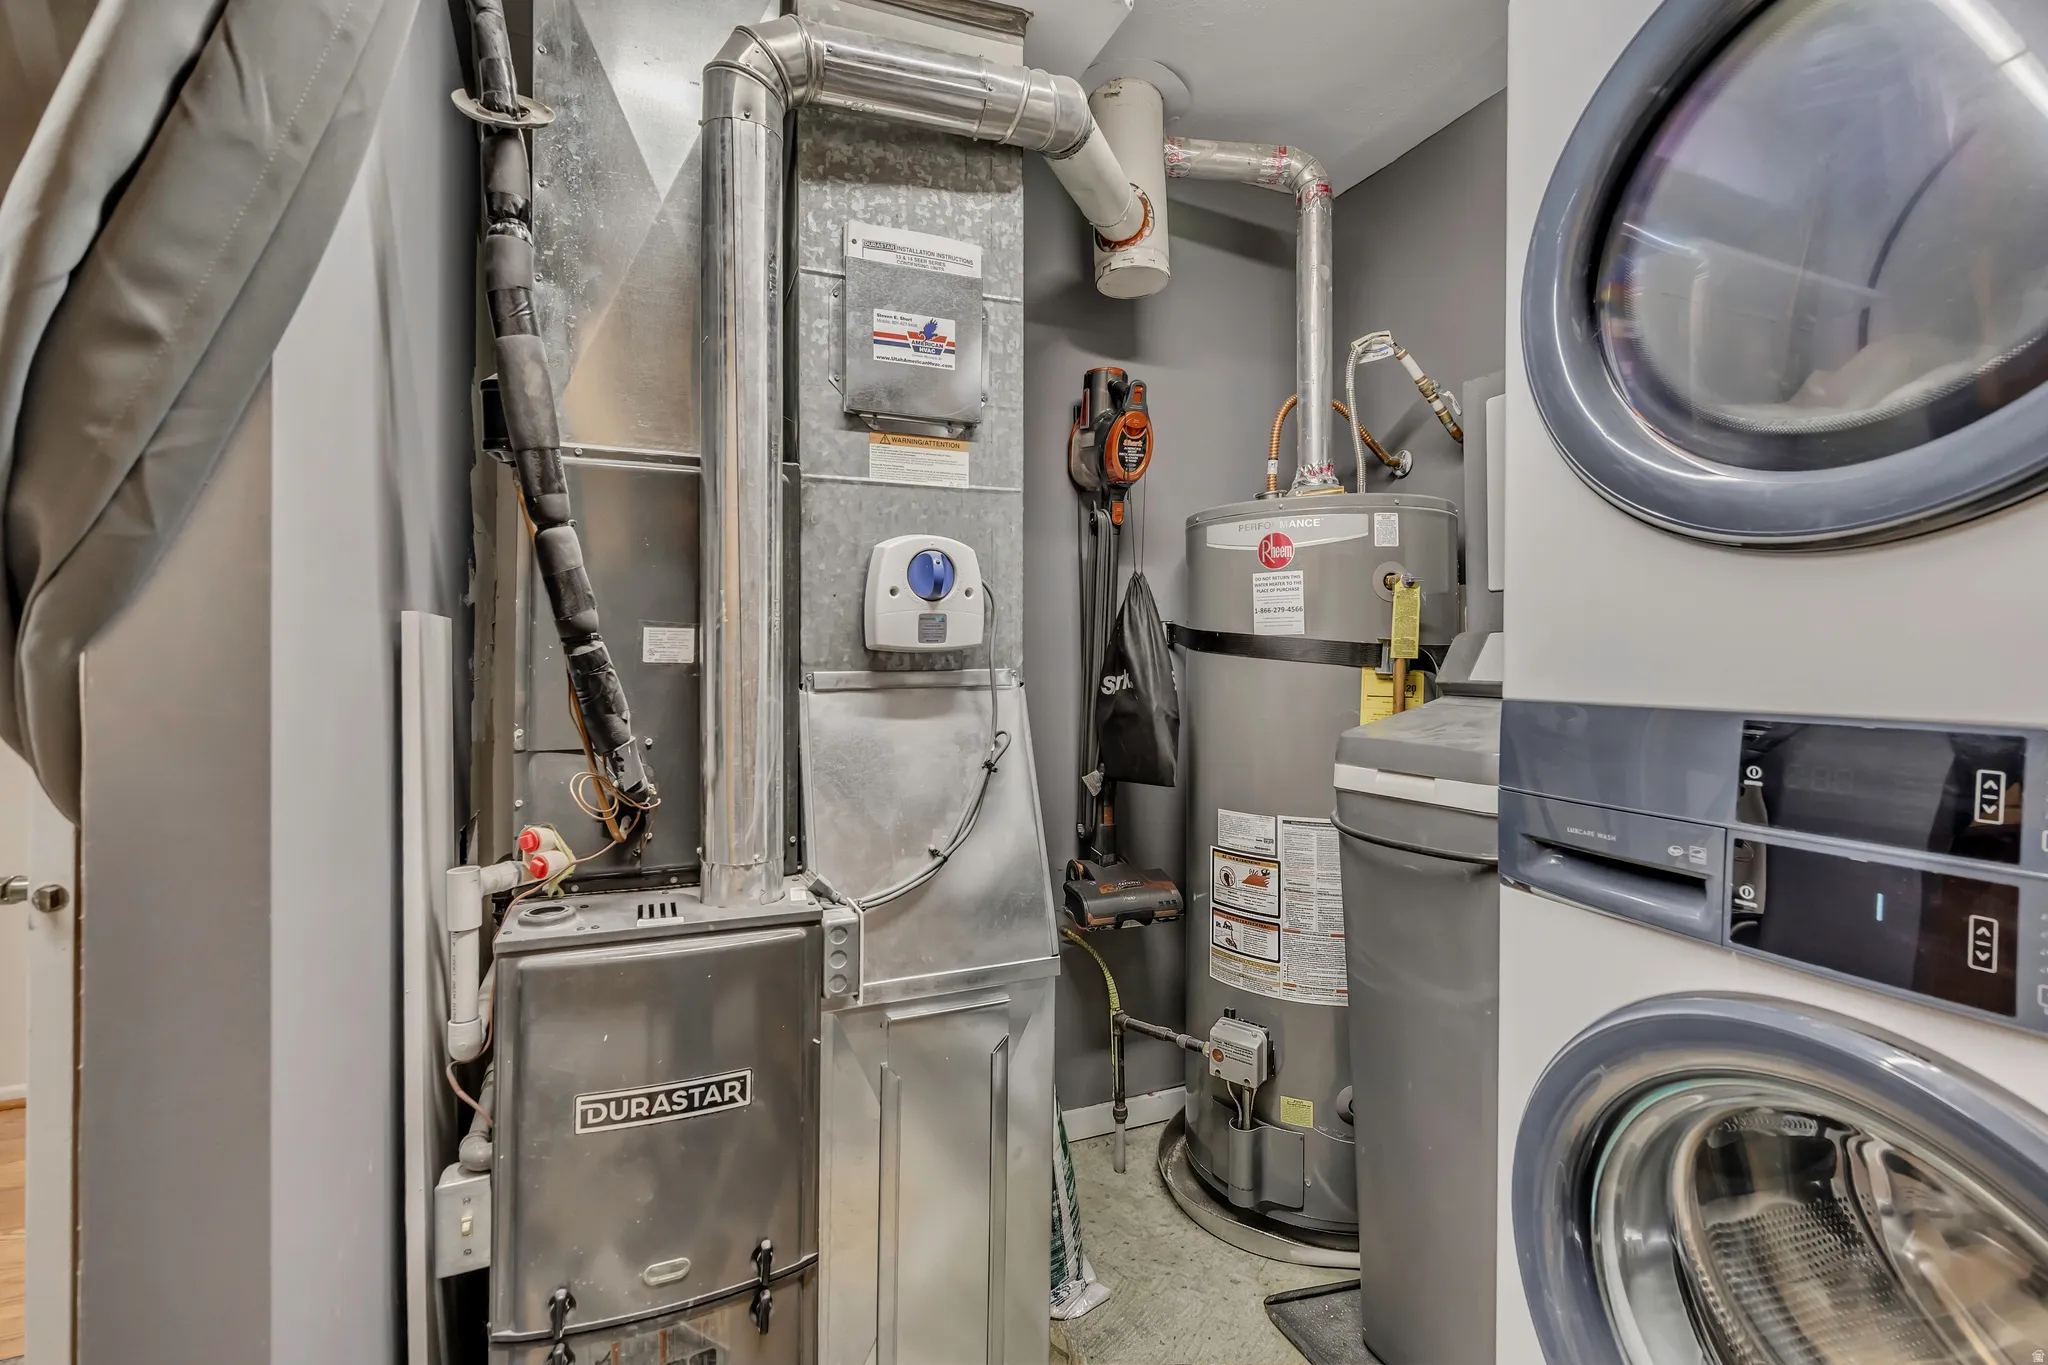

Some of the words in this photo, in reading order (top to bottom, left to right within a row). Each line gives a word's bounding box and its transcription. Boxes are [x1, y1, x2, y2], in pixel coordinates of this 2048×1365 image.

[897, 245, 935, 257] INSTALLATION
[936, 252, 974, 266] INSTRUCTIONS
[911, 340, 944, 349] AMERICAN
[891, 437, 960, 449] WARNING/ATTENTION
[1261, 534, 1293, 563] Rheem
[1254, 606, 1304, 614] 1-866-279-4566
[1566, 826, 1595, 838] LUXCARE
[1597, 833, 1617, 842] WASH
[582, 1080, 745, 1125] DURASTAR
